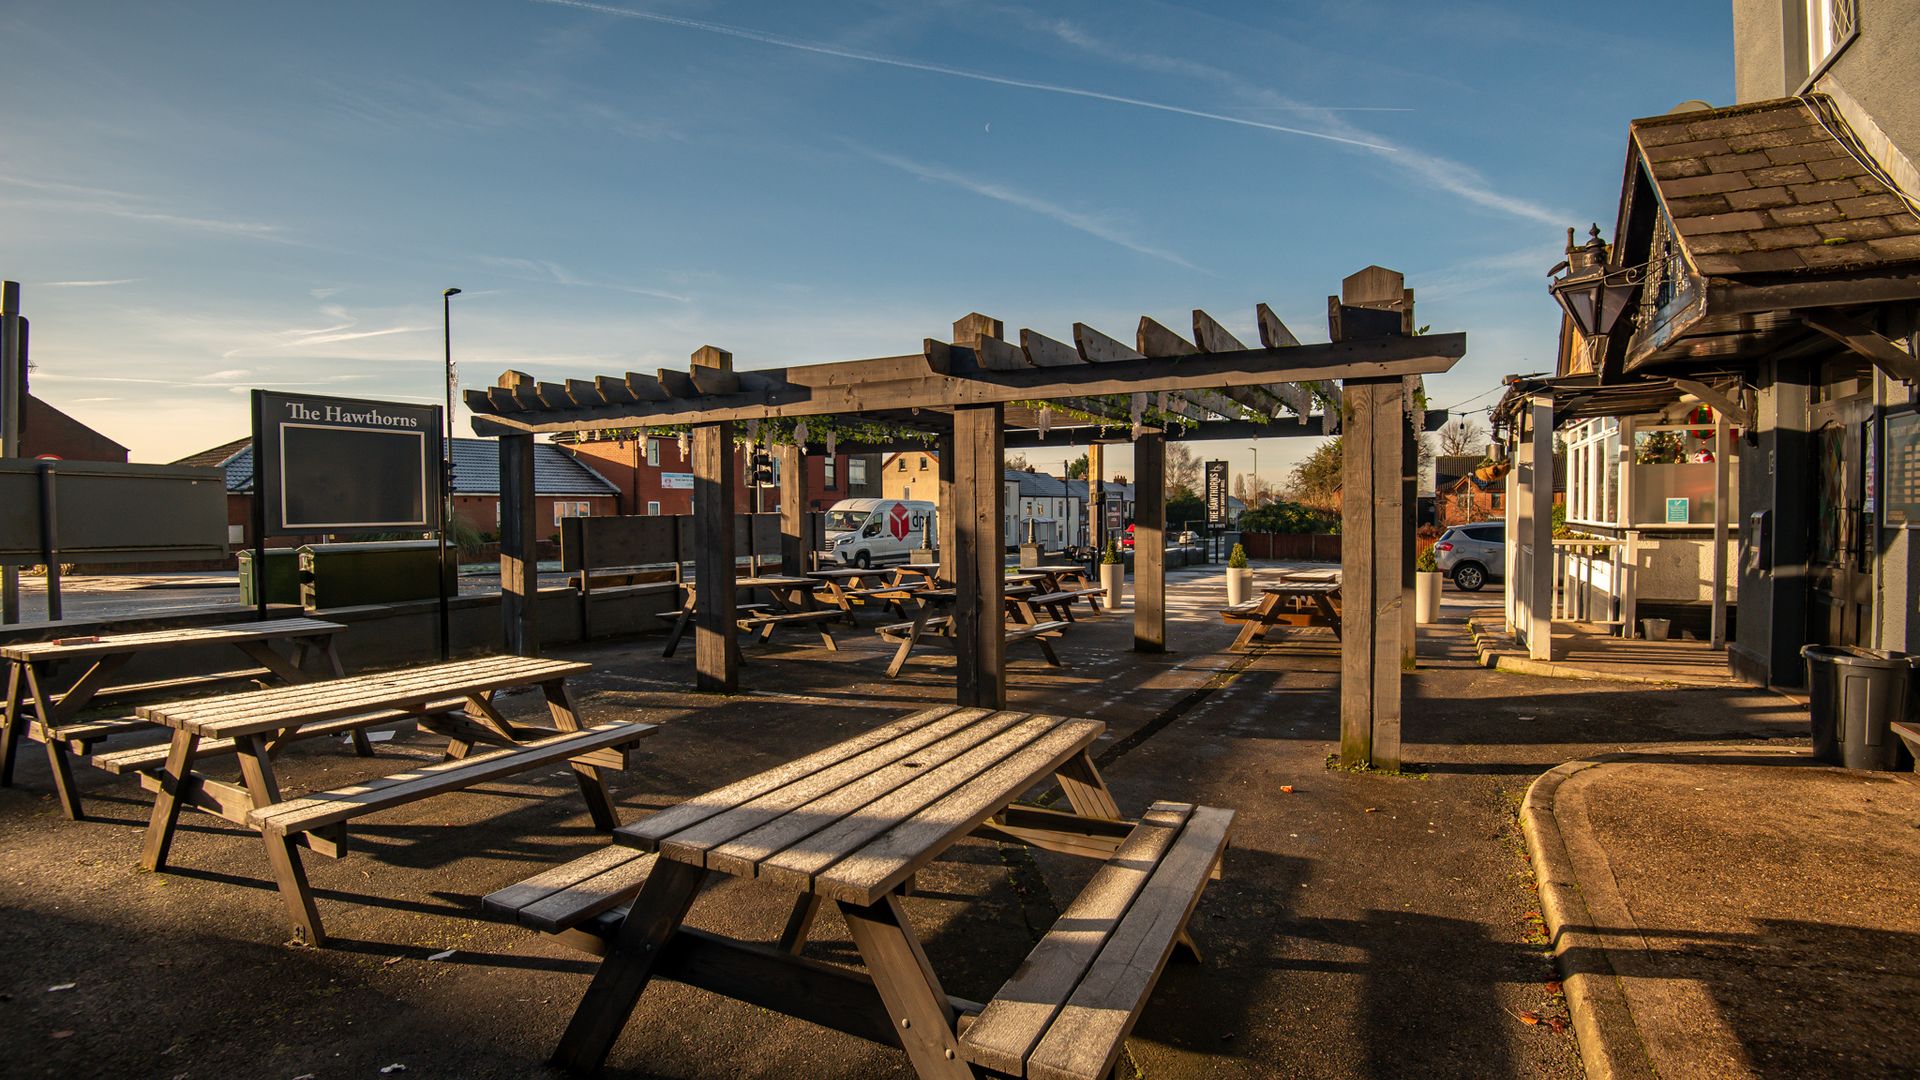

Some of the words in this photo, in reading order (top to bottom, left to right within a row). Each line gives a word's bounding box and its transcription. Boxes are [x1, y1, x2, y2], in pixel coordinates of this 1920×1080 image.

[285, 402, 320, 420] The
[324, 405, 417, 427] Hawthorns
[1207, 472, 1221, 510] HAWTHORNS
[1209, 510, 1219, 522] THE
